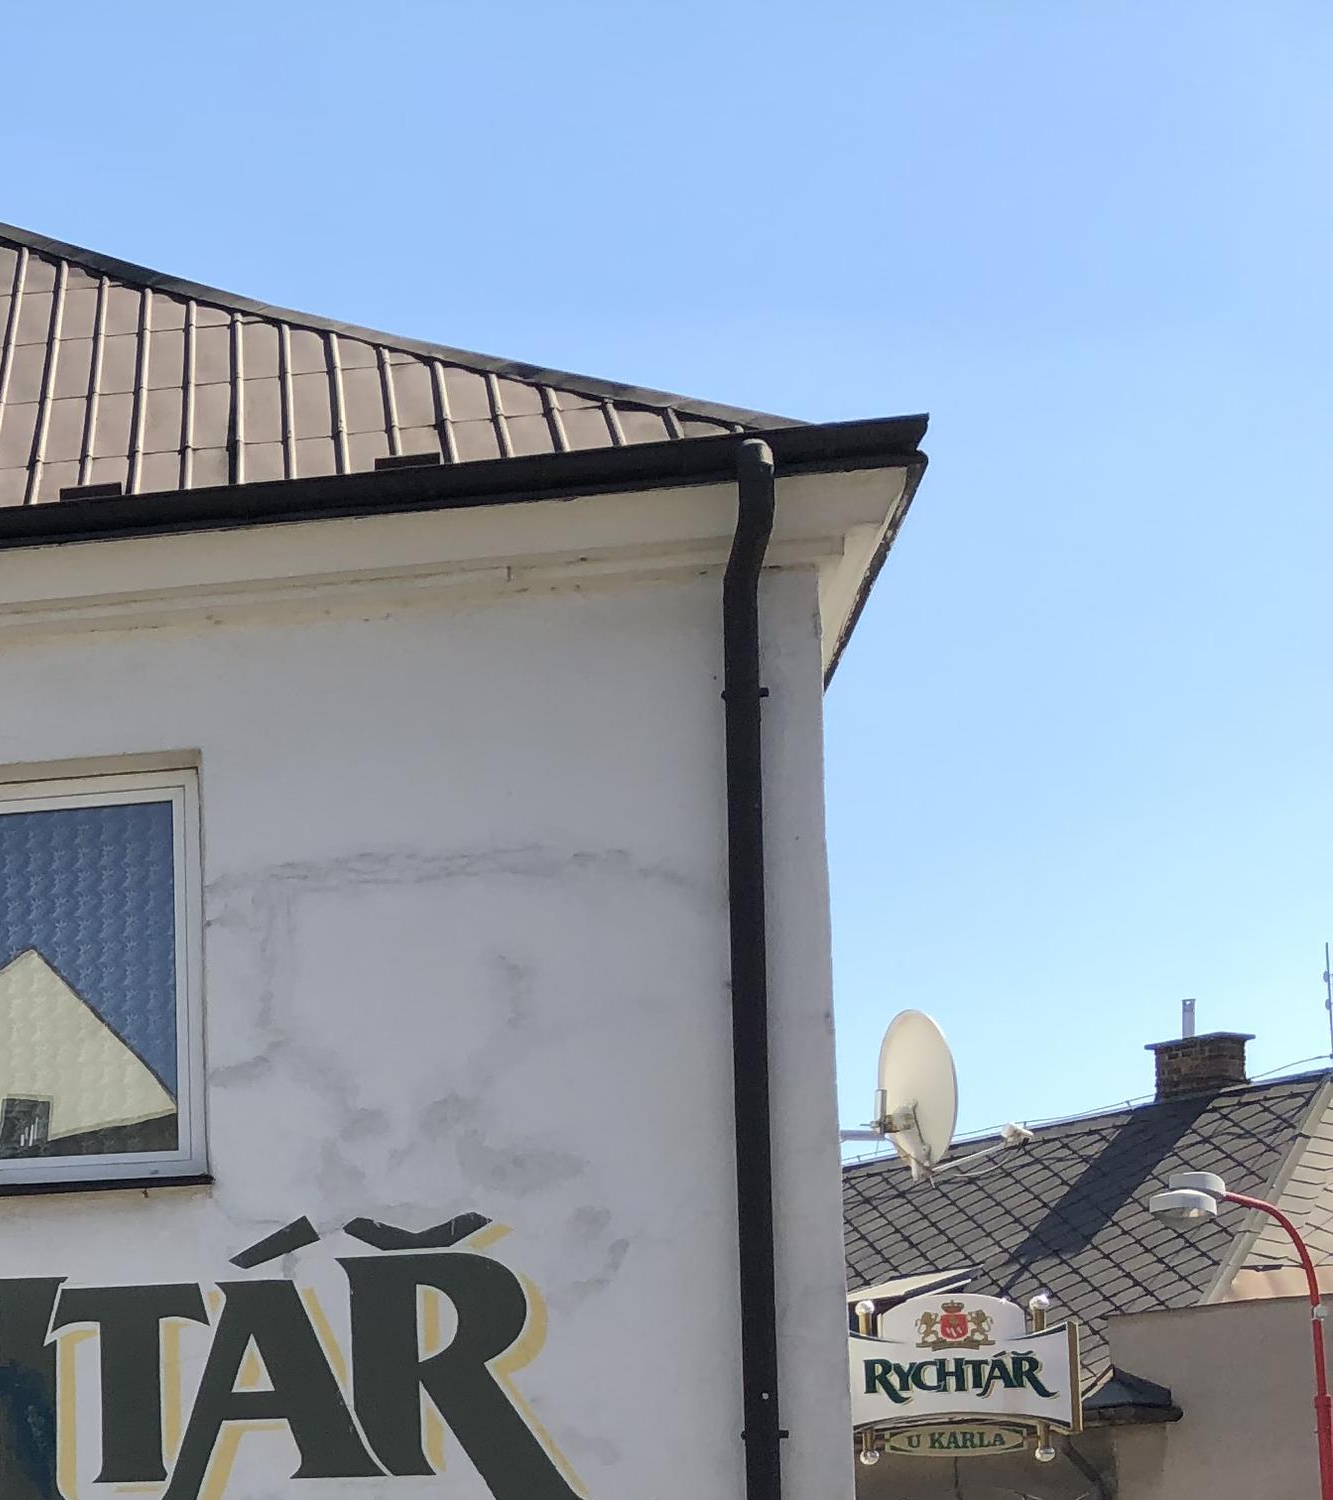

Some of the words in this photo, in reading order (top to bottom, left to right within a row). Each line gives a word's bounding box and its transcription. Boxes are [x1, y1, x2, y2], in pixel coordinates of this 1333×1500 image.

[863, 1350, 1061, 1404] RYCHTÁŘ
[906, 1433, 922, 1448] U
[928, 1431, 1006, 1450] KARLA
